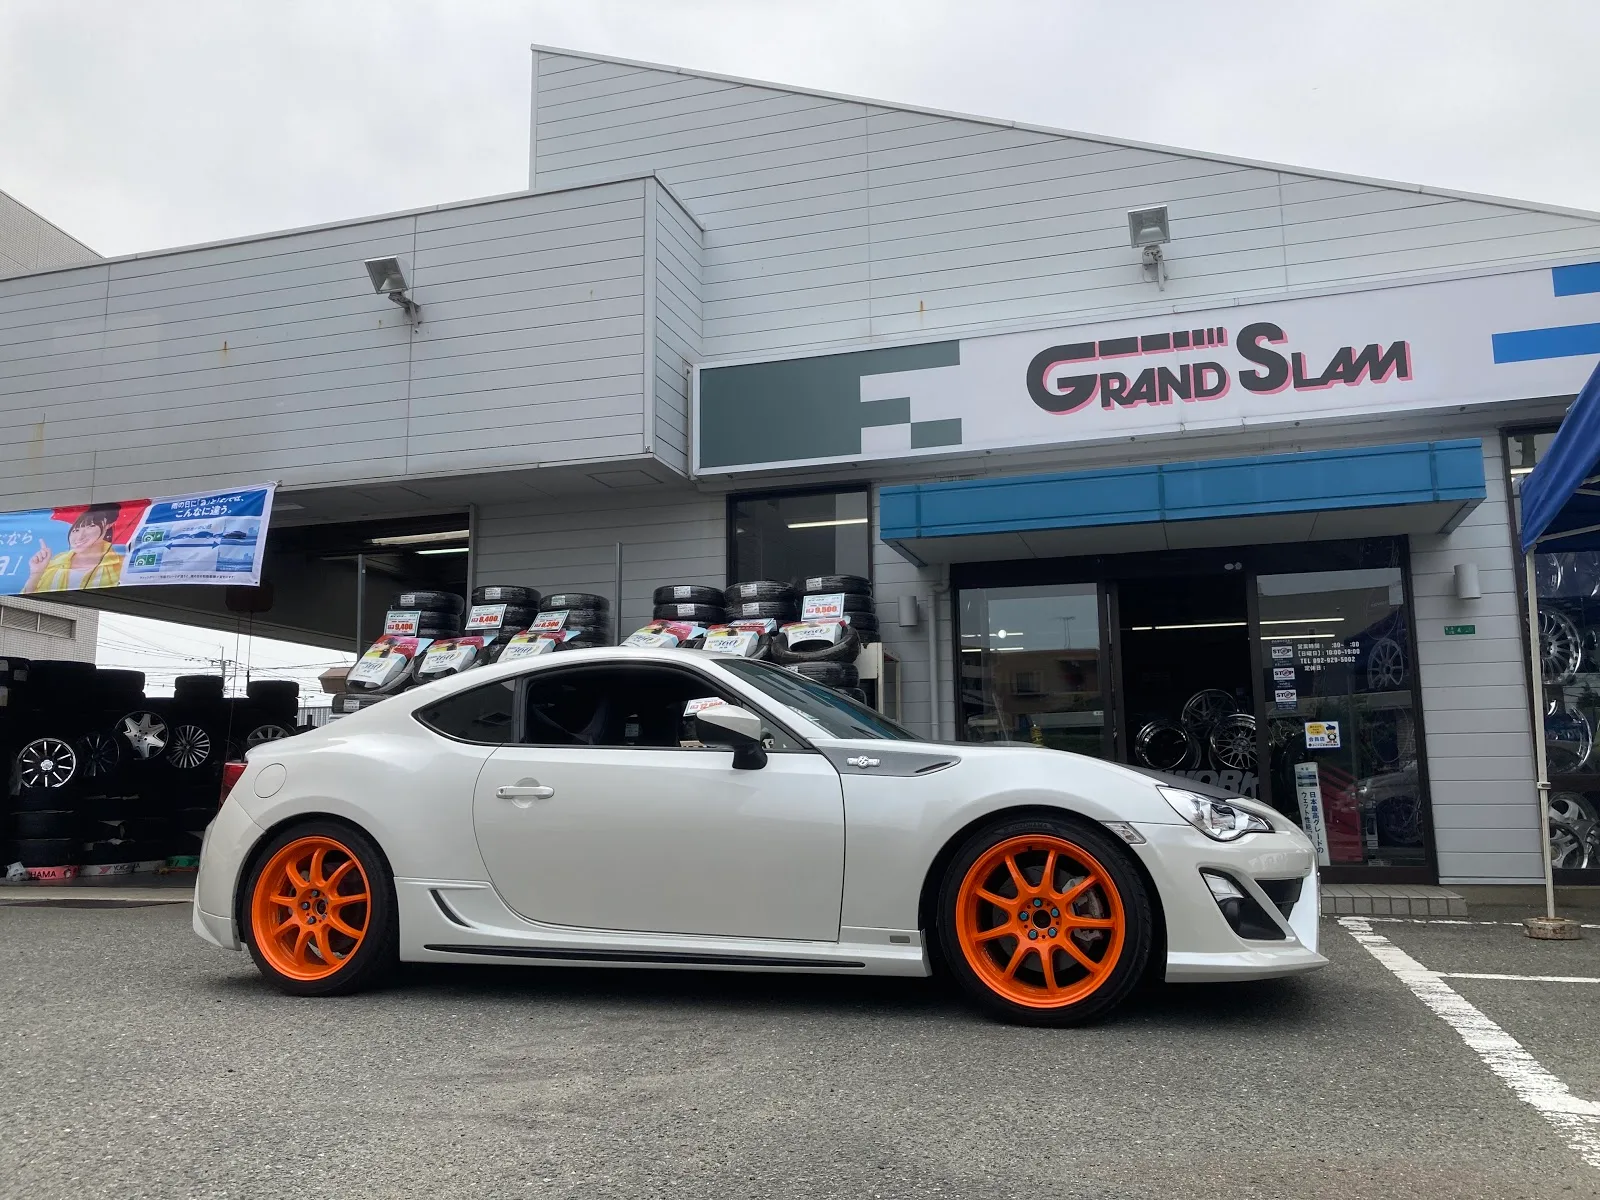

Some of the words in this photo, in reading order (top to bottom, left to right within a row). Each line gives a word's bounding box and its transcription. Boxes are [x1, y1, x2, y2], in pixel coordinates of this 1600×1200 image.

[1027, 327, 1231, 415] GRAND
[1236, 322, 1413, 396] SLAM
[1309, 791, 1324, 854] 日本最高グレードの
[28, 870, 57, 879] HAMA
